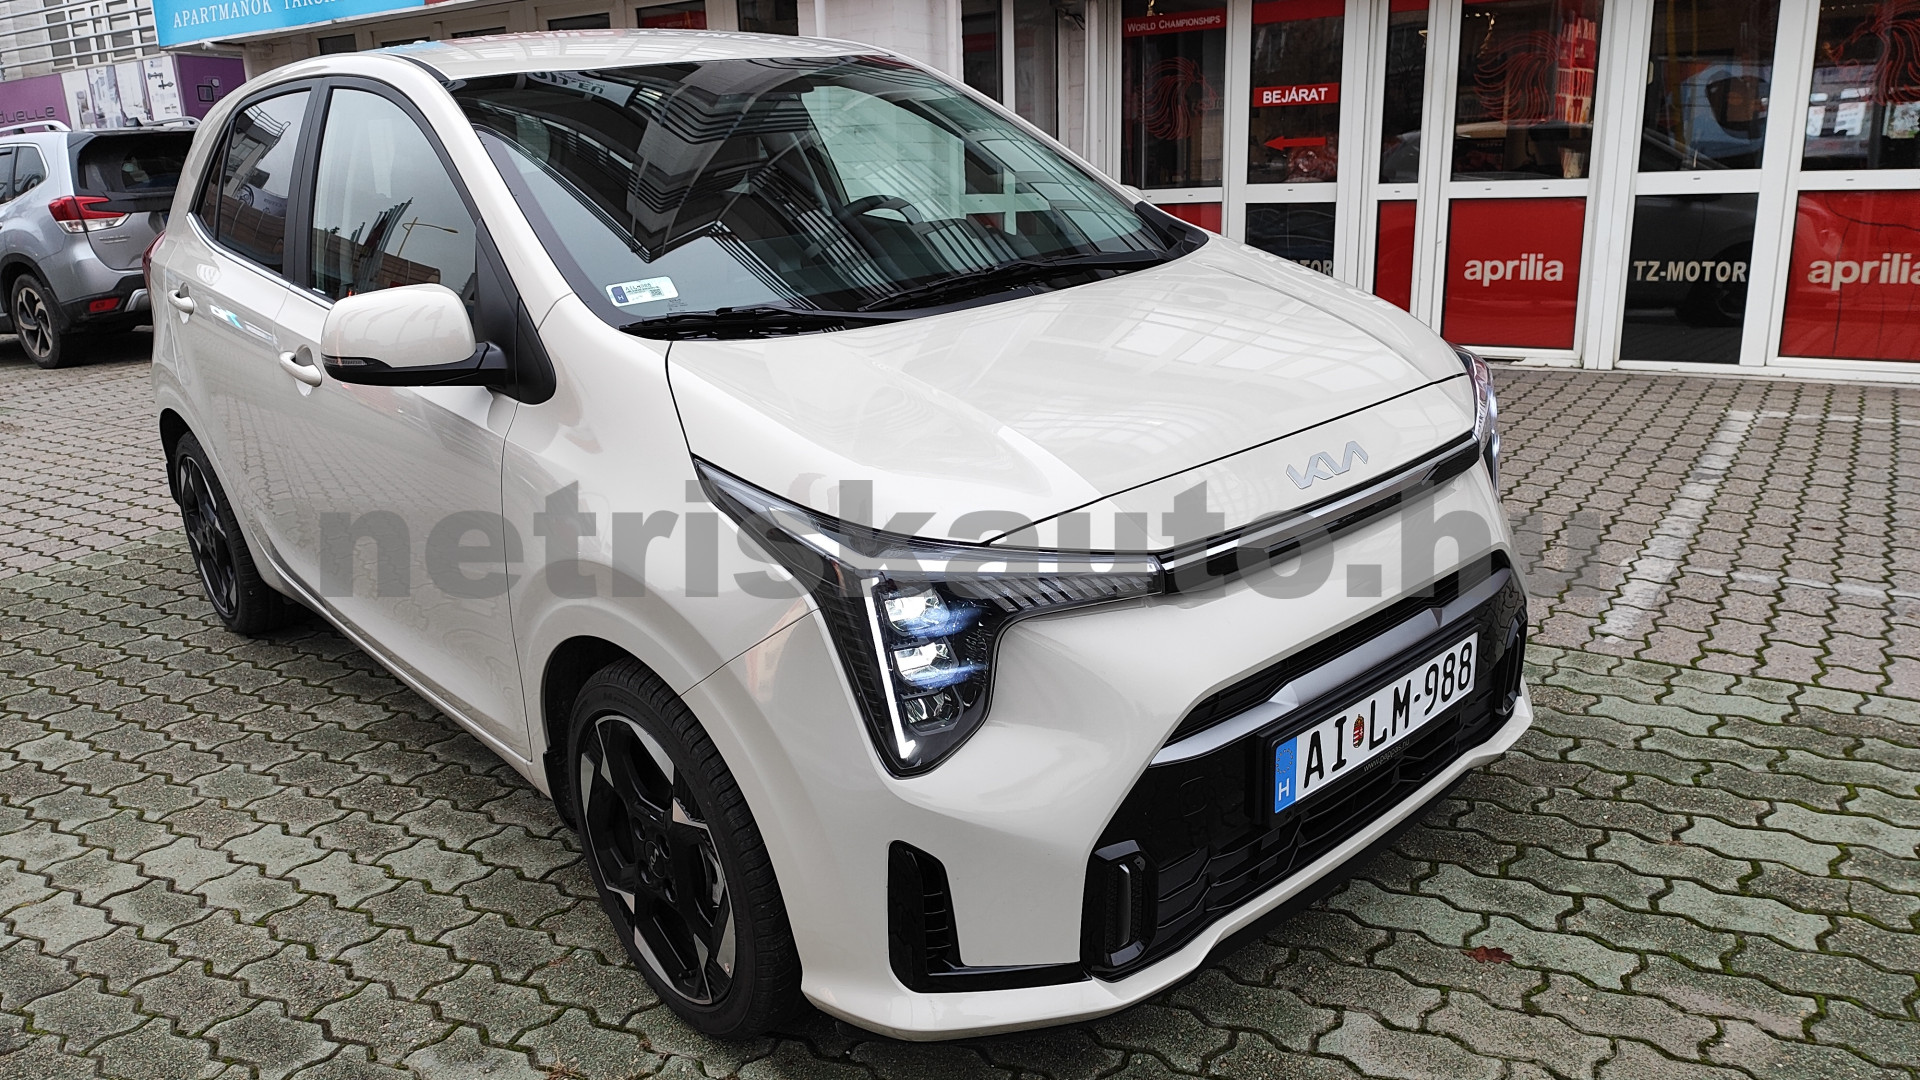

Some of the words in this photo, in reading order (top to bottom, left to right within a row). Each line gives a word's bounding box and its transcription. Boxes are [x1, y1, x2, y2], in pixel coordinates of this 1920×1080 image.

[173, 0, 273, 29] APARTMANOK
[1262, 86, 1329, 104] BEJÁRAT
[1463, 253, 1564, 287] aprilia
[1633, 261, 1747, 282] TZ-MOTOR
[1807, 253, 1920, 291] aprilia
[1285, 440, 1369, 490] KIA
[1278, 778, 1290, 801] H
